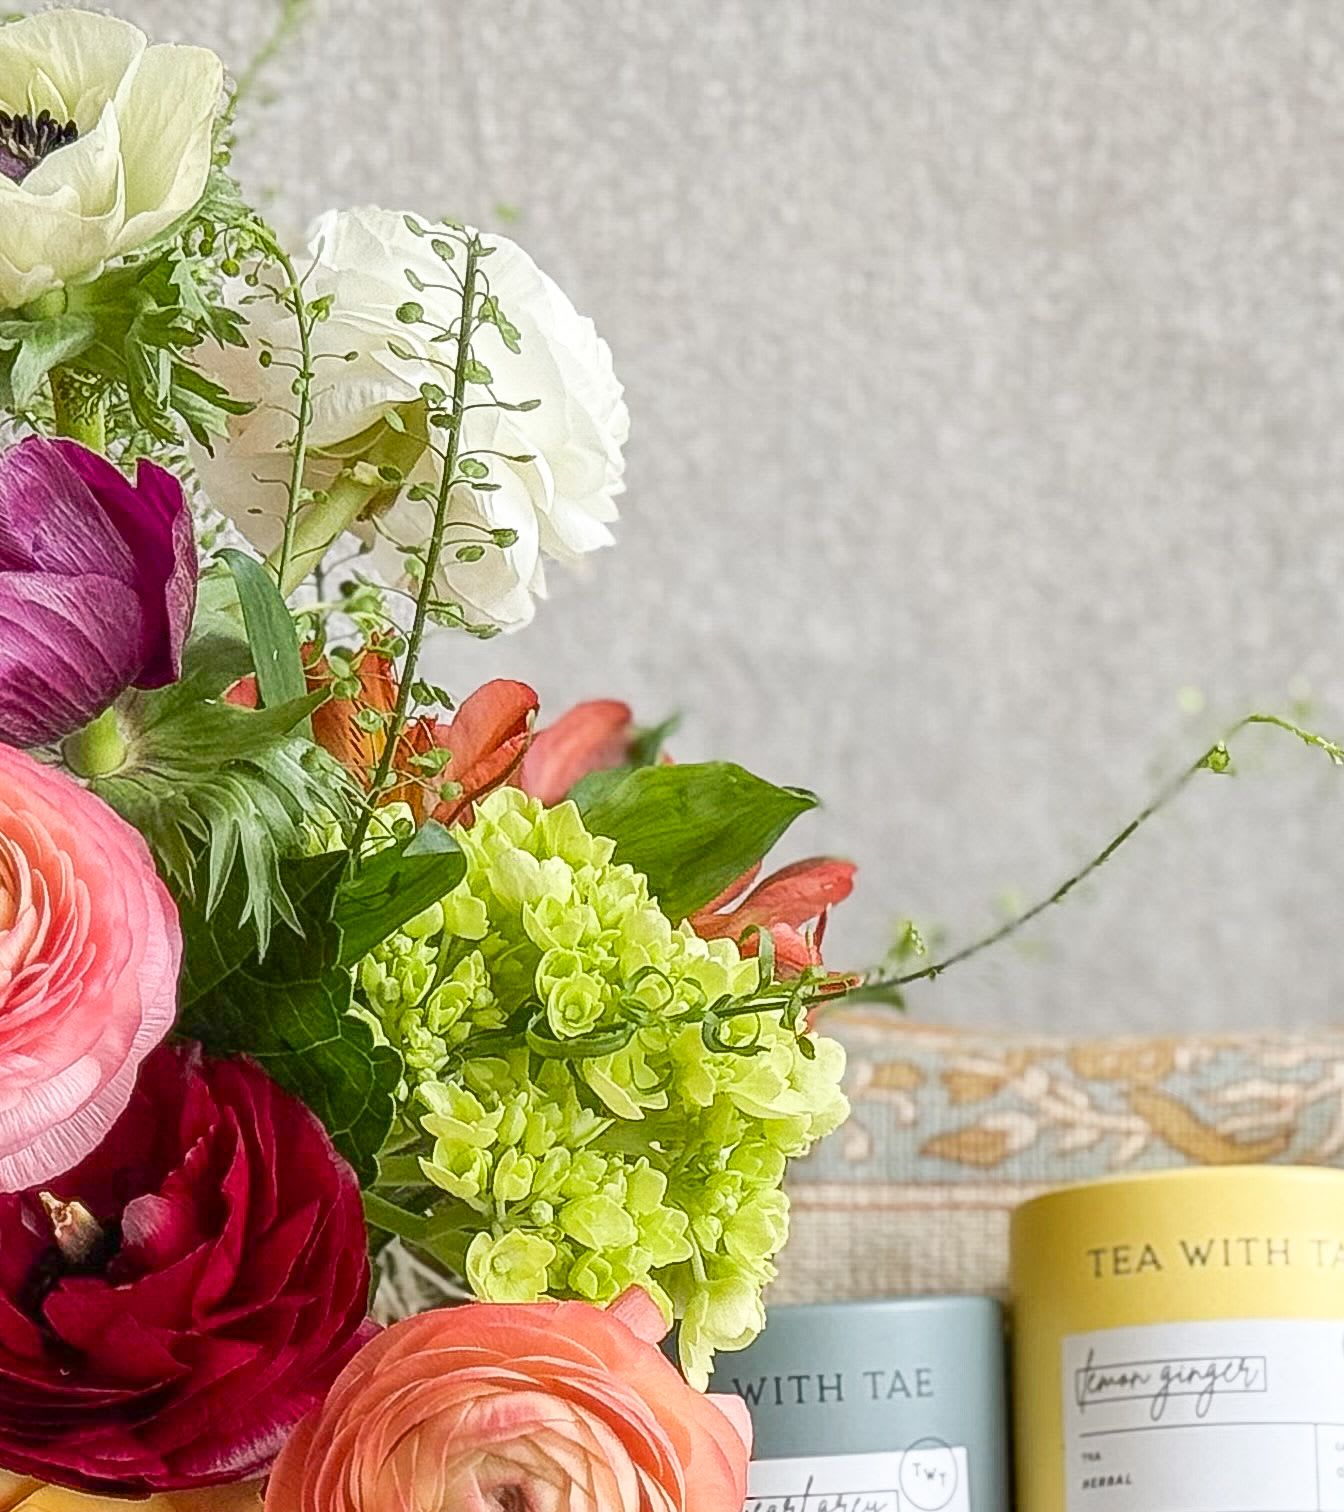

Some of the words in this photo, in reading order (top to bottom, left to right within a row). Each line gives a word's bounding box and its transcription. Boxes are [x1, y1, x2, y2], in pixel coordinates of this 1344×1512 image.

[1088, 1244, 1162, 1279] TEA
[1179, 1237, 1290, 1267] WITH
[732, 1373, 843, 1406] WITH
[863, 1368, 934, 1400] TAE
[1079, 1348, 1150, 1414] lemon
[1151, 1357, 1259, 1421] ginger
[1082, 1475, 1133, 1490] HERBAL
